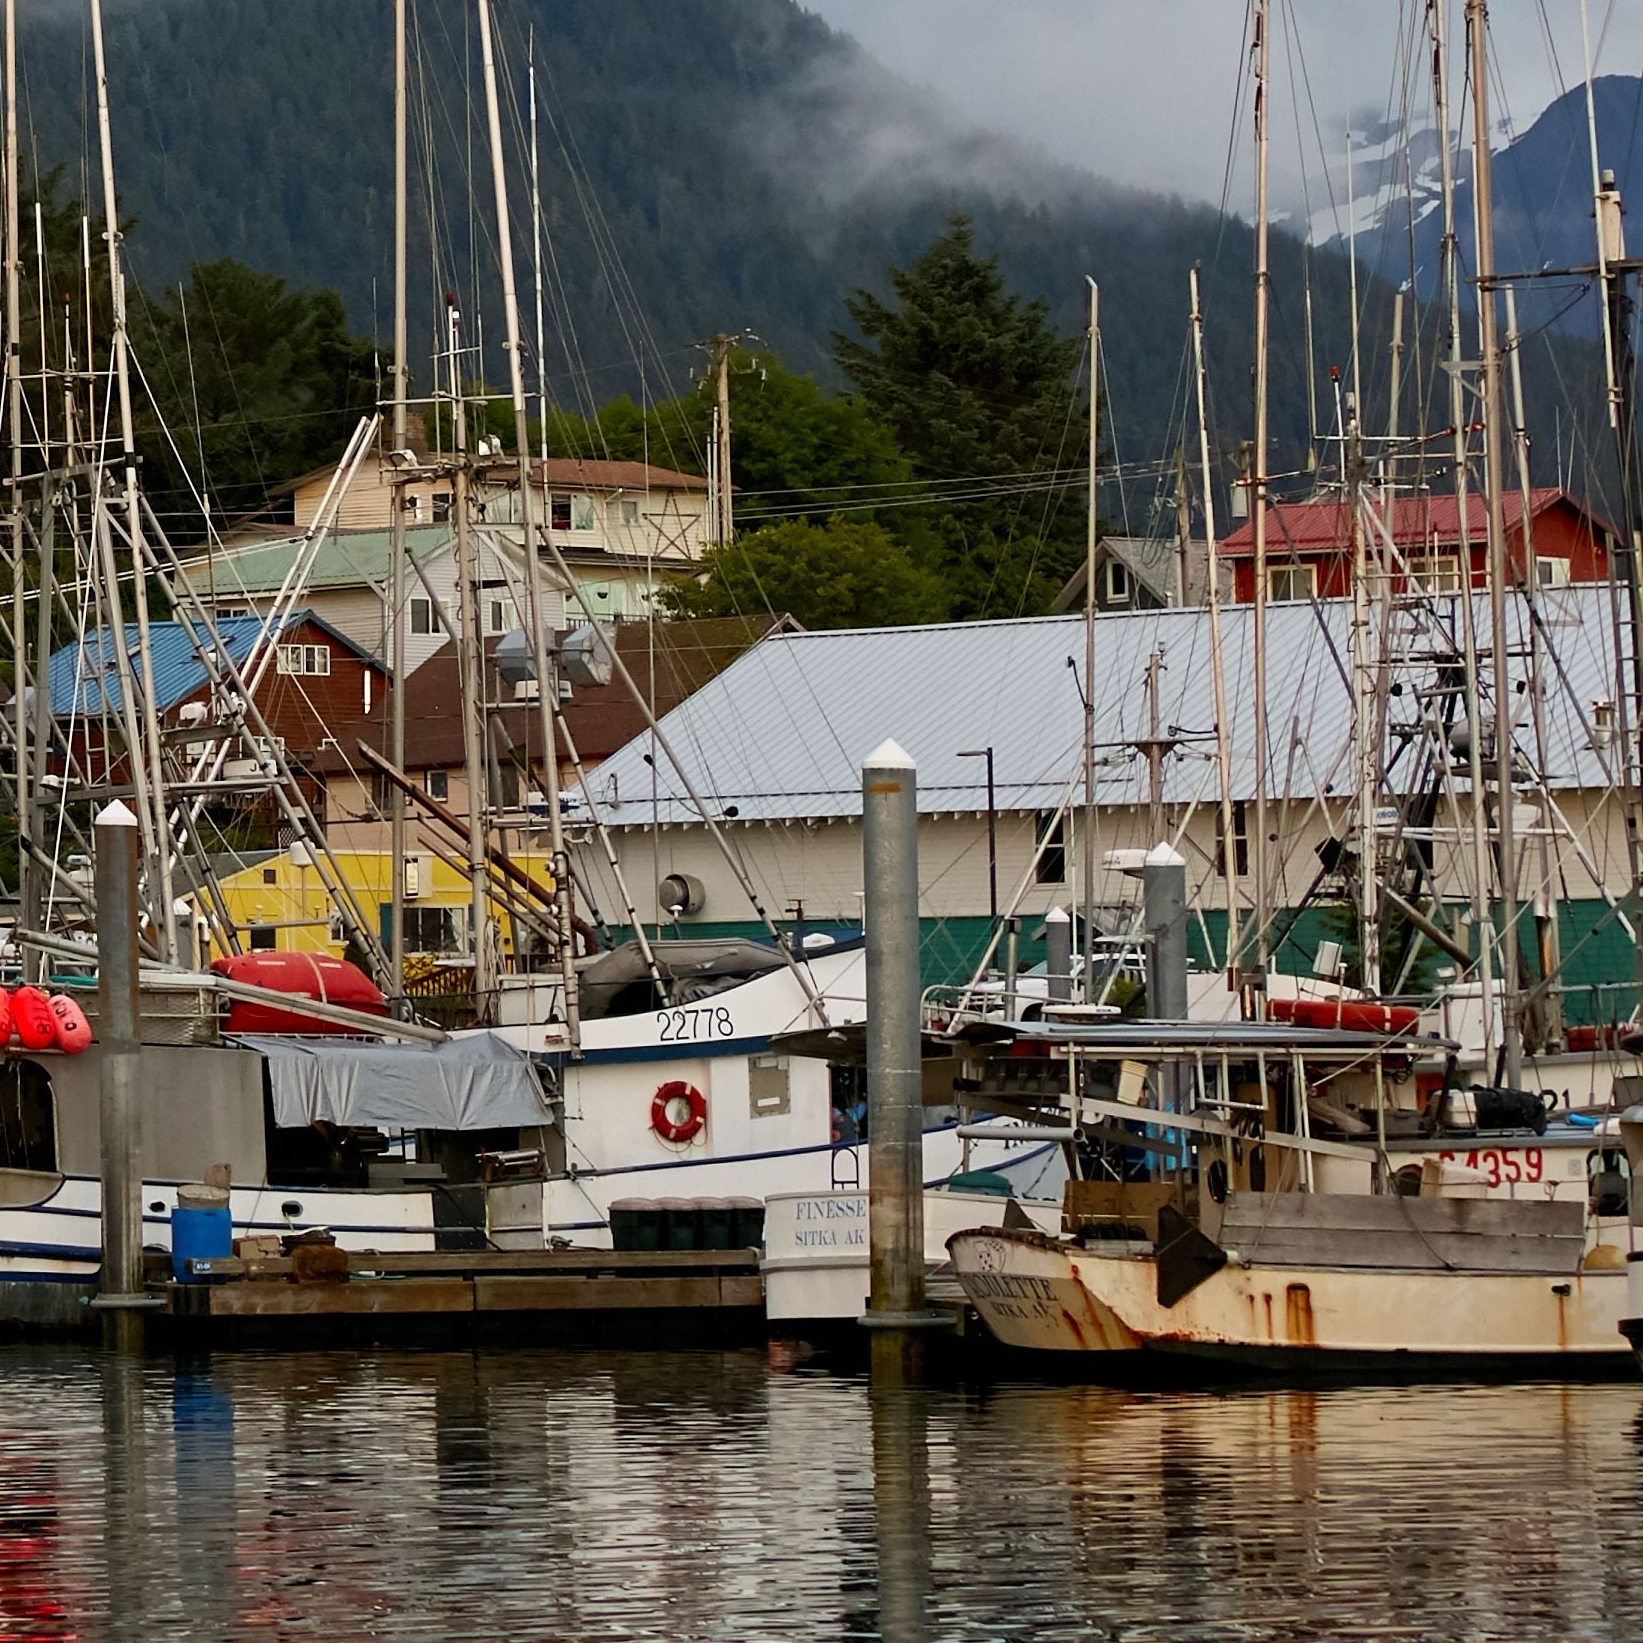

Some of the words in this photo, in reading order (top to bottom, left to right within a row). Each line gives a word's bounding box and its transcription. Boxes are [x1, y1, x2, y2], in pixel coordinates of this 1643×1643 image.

[656, 1007, 734, 1042] 22778
[795, 1229, 837, 1246] SITKA
[844, 1229, 865, 1245] AK
